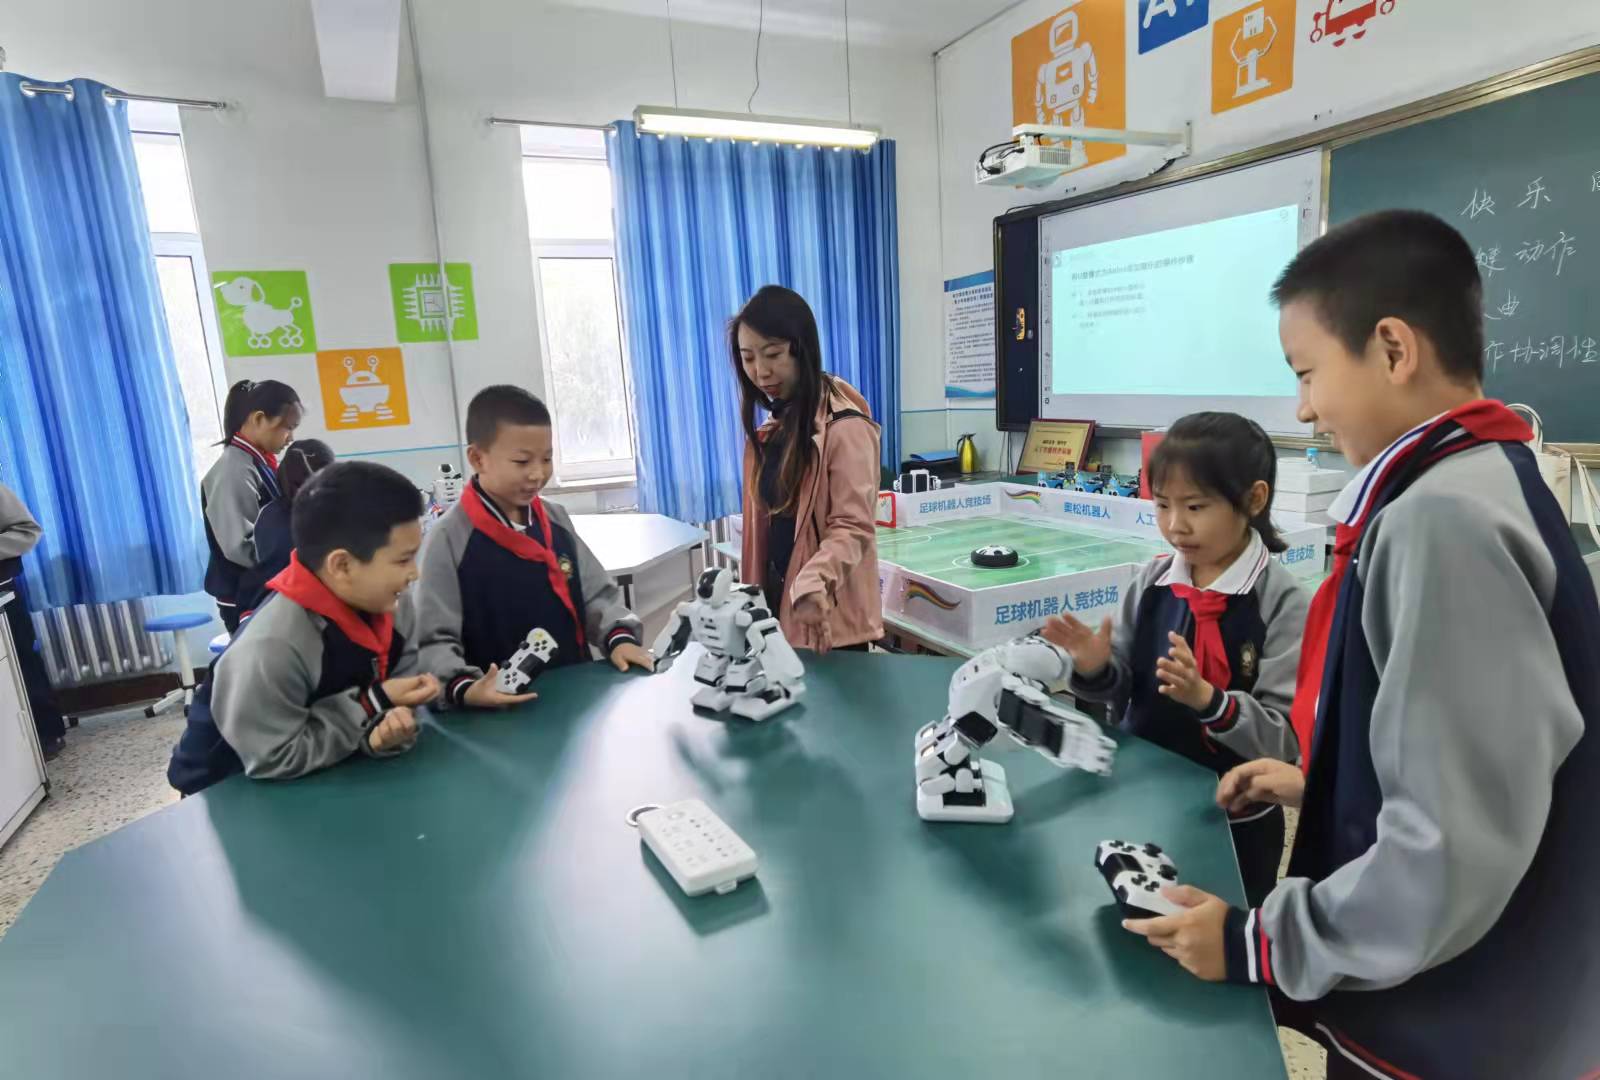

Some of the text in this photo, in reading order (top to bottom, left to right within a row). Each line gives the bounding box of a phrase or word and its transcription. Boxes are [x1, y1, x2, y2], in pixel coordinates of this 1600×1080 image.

[919, 495, 992, 513] 足球机器人竞技场
[1064, 502, 1111, 519] 奥松机器人
[994, 586, 1119, 624] 足球机器人竞技场
